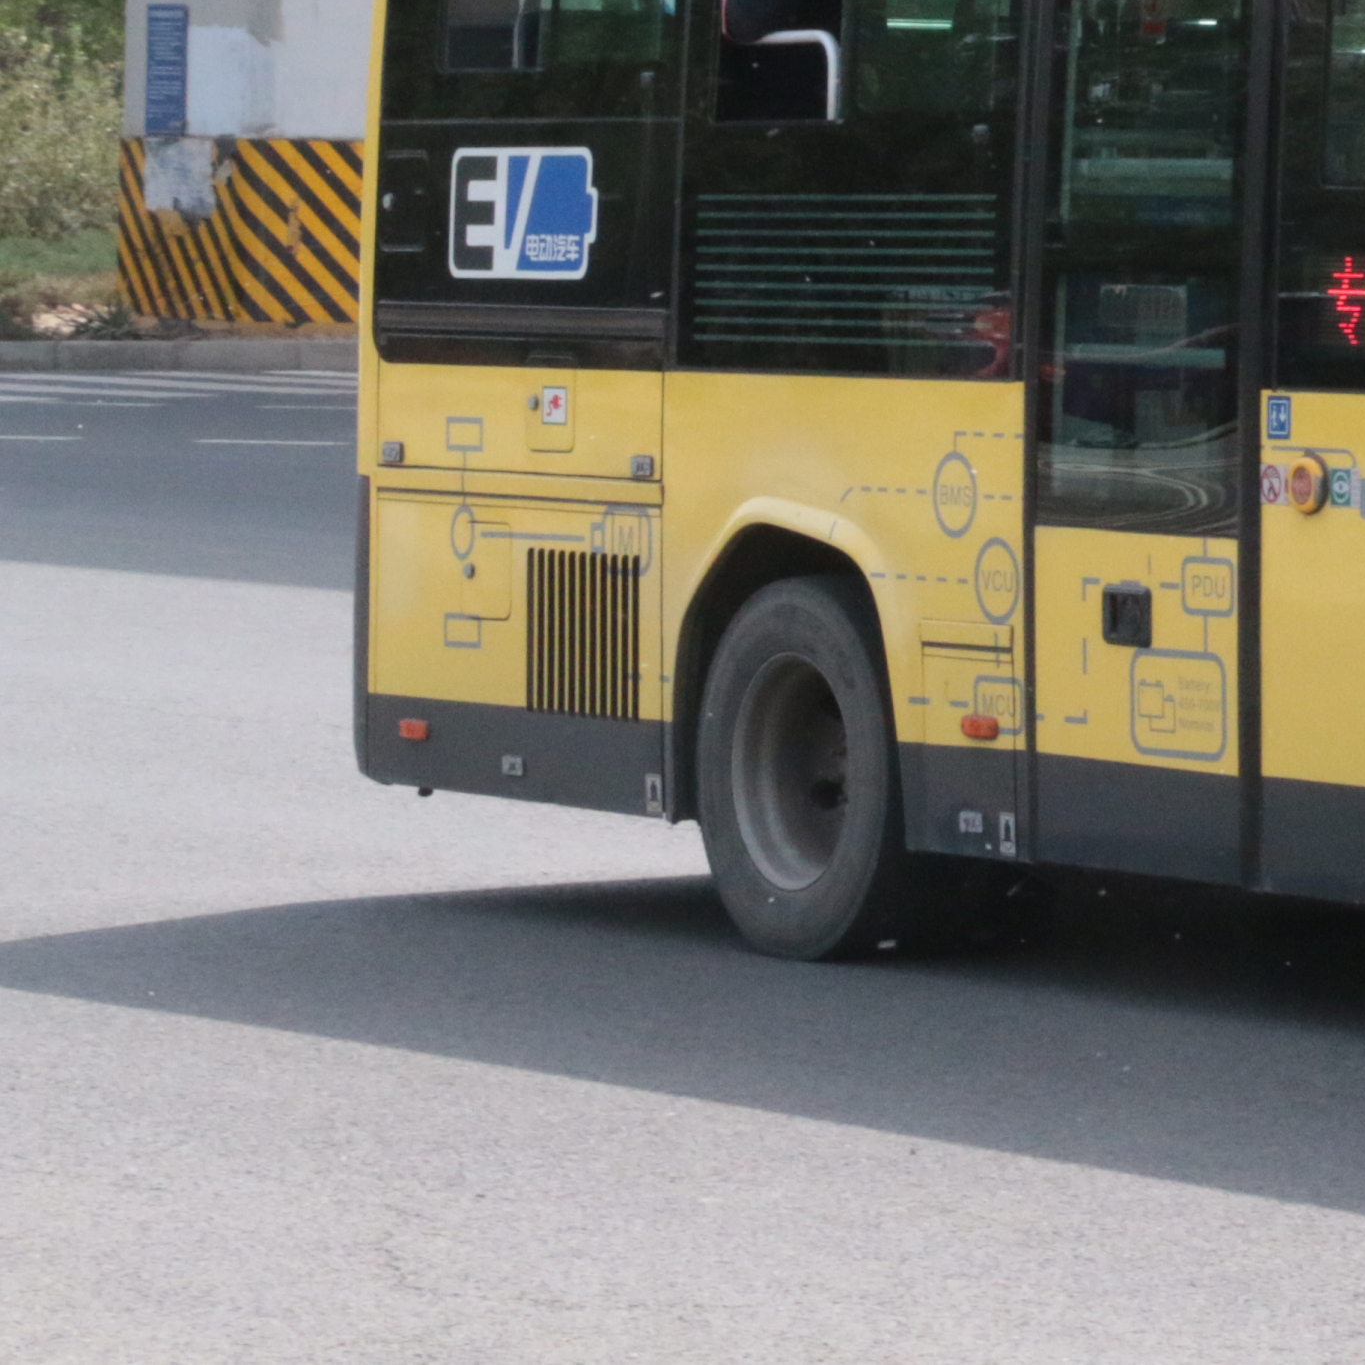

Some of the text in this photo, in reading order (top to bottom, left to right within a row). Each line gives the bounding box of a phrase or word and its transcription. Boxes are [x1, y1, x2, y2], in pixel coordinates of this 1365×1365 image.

[525, 234, 580, 262] 电动汽车
[939, 484, 973, 507] BMS
[980, 568, 1014, 593] VCU
[1190, 575, 1226, 600] PDU
